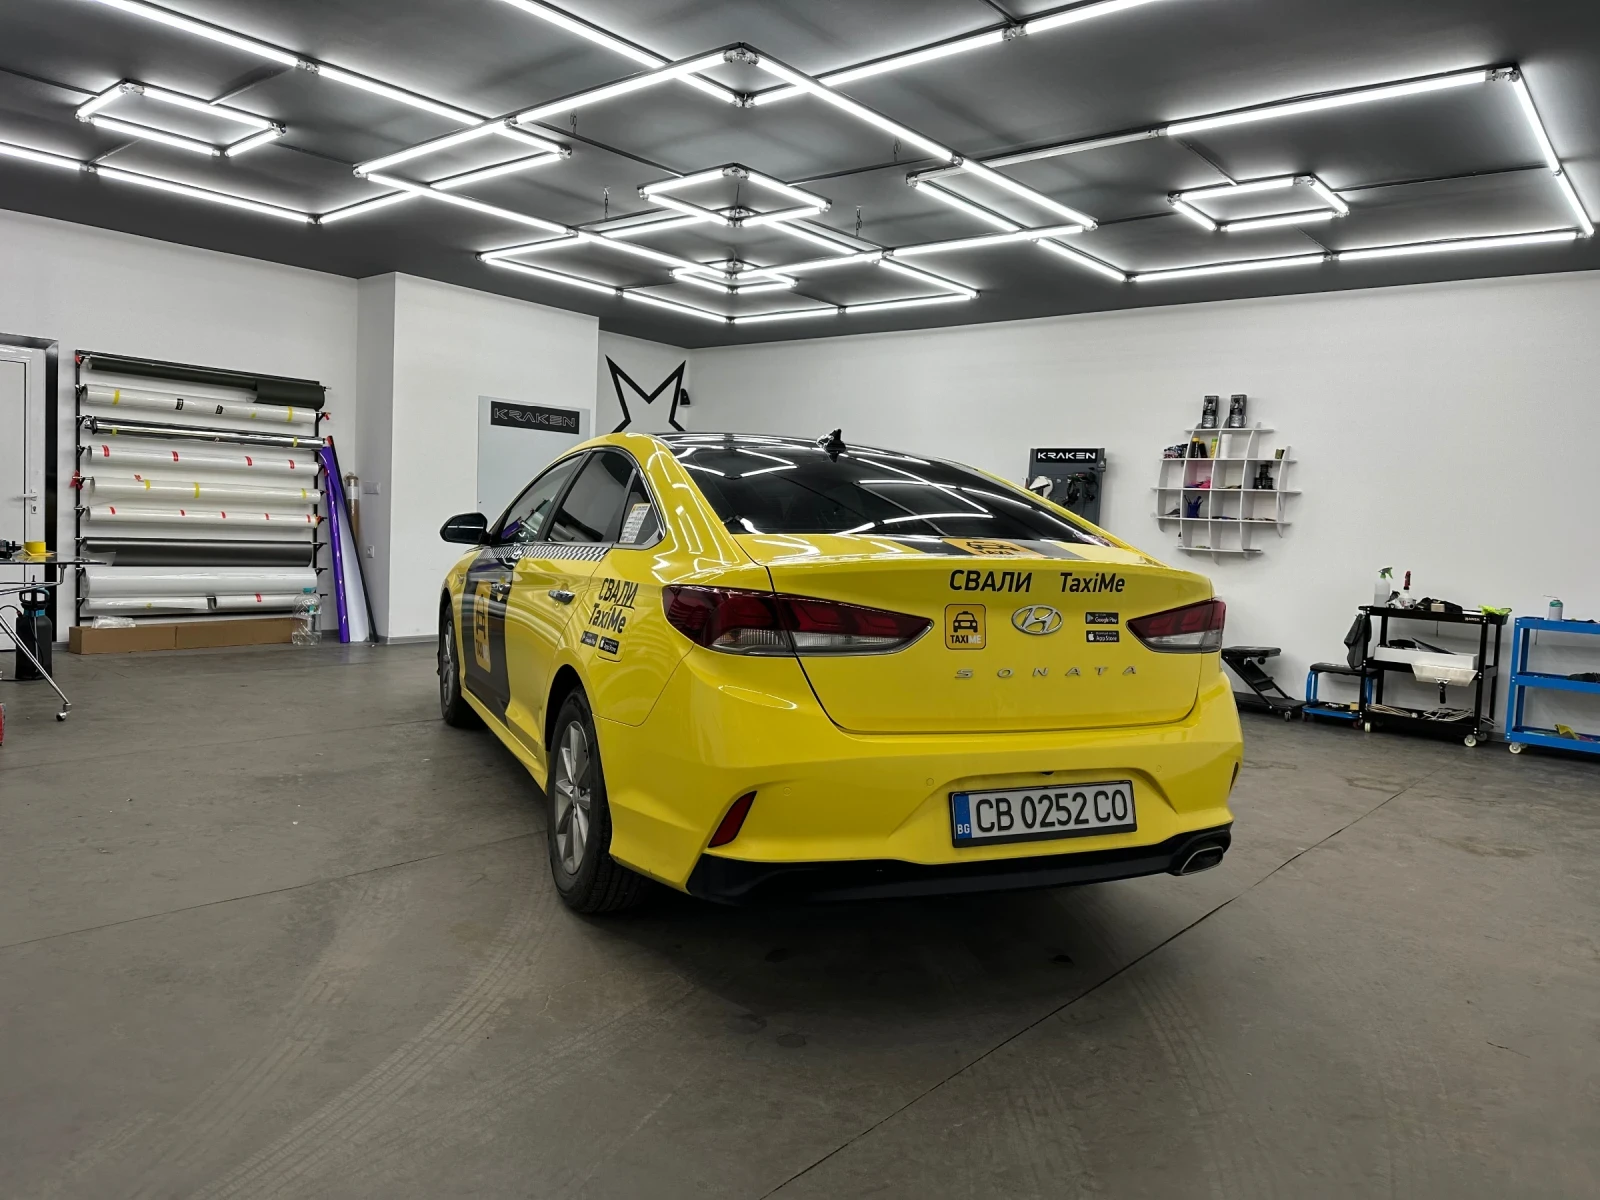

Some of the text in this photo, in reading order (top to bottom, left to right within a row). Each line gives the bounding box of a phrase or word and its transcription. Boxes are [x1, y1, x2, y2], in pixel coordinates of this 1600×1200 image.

[494, 408, 576, 428] KRAKEN
[598, 577, 639, 608] СВАЛИ
[949, 569, 1125, 593] СВАЛИ TaxiMe
[588, 602, 627, 634] TaxiMe
[955, 665, 1137, 680] SONATA
[976, 790, 1128, 833] CB 0252 CO
[957, 823, 970, 835] BG
